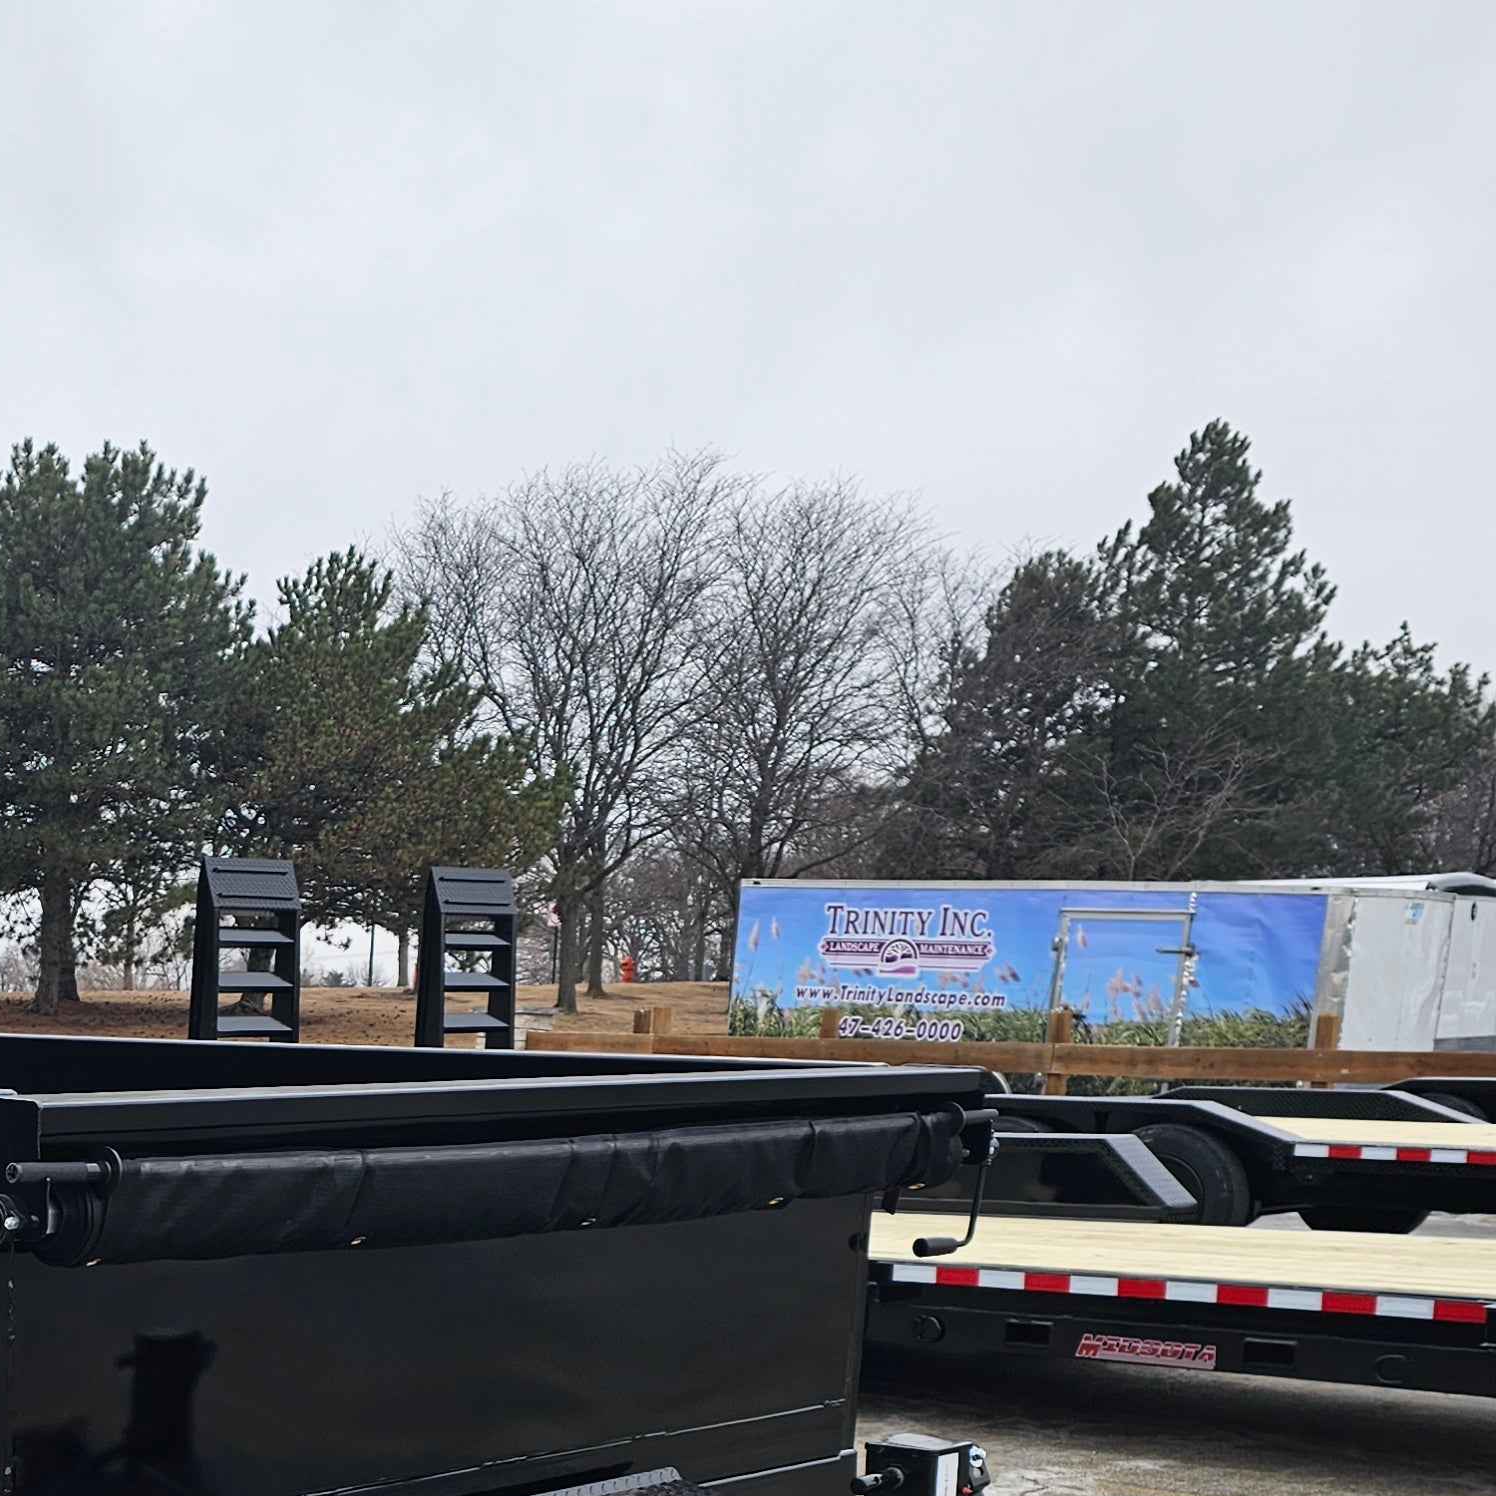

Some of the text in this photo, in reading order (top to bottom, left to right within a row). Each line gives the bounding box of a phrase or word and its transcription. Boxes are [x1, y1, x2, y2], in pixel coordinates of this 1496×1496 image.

[826, 904, 992, 938] TRINITY INC.
[829, 941, 985, 956] LANDSCAPE MAINTENANCE
[796, 985, 1005, 1008] www.TrinityLandscape.com
[838, 1017, 962, 1041] 47-426-0000
[1076, 1333, 1216, 1365] MIDSOTA
